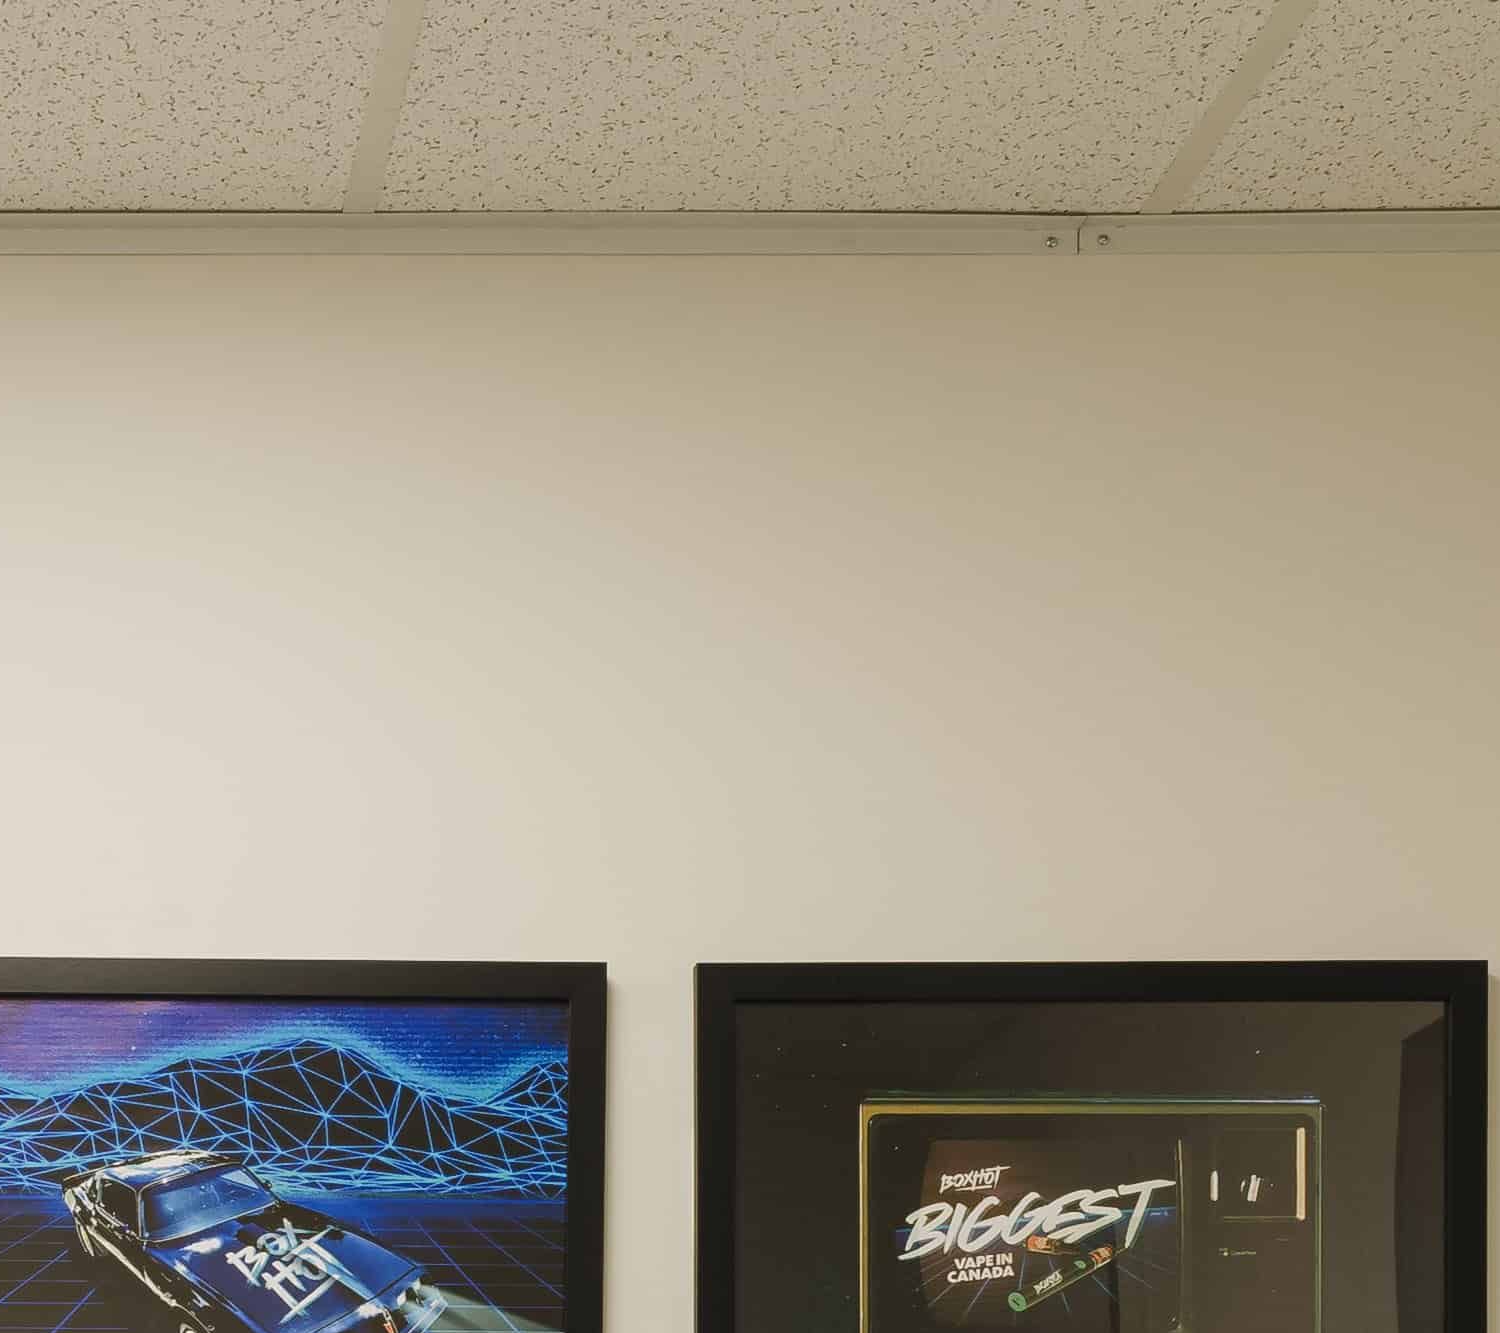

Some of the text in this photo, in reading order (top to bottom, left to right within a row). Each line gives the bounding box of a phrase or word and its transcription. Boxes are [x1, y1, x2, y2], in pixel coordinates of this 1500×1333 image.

[225, 1217, 320, 1288] BOX
[898, 1179, 1176, 1260] BIGGEST
[261, 1225, 354, 1321] HOT
[947, 1265, 1015, 1283] CANADA
[954, 1253, 1013, 1271] VAPE IN
